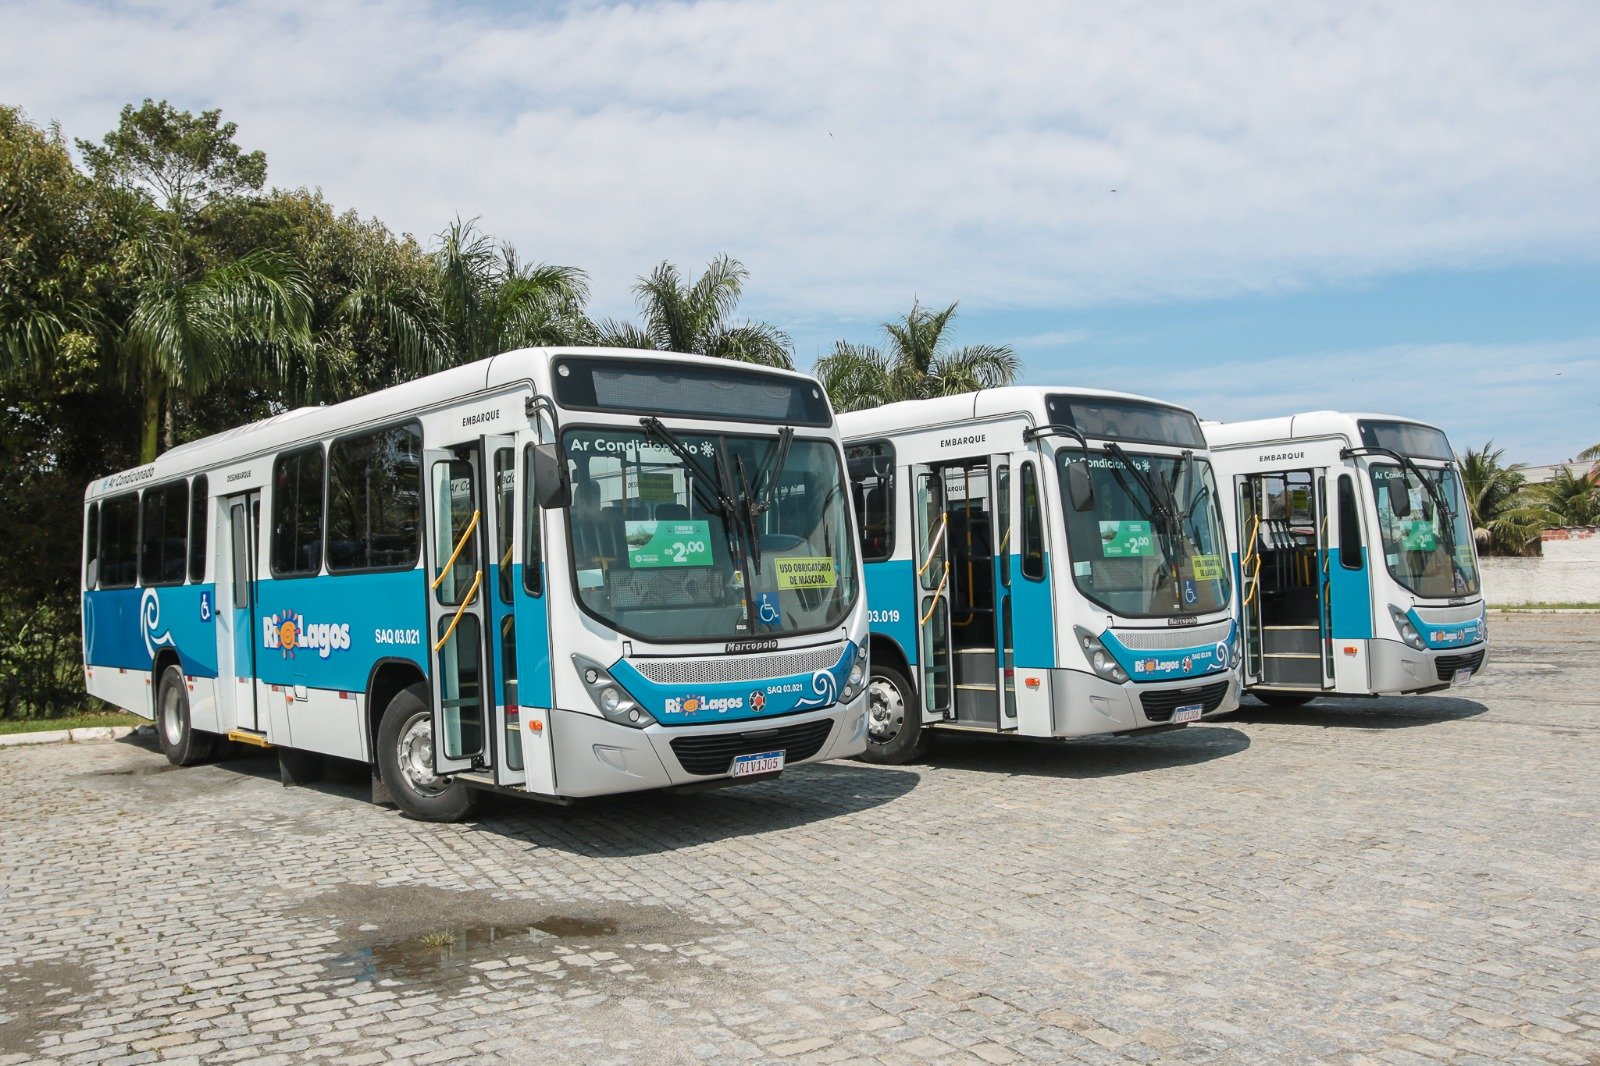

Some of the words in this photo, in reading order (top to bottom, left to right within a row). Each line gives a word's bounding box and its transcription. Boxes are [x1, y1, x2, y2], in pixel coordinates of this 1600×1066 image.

[462, 409, 500, 427] EMBARQUE
[570, 438, 590, 451] Ar
[940, 434, 986, 448] EMBARQUE
[1259, 451, 1305, 462] EMBARQUE
[945, 484, 966, 493] ARQUE
[779, 563, 792, 573] USO
[793, 560, 831, 573] OBRIGATÓRIO
[789, 575, 798, 585] DE
[868, 609, 900, 623] 03.019
[375, 628, 394, 644] SAQ
[395, 628, 420, 645] 03.021
[726, 640, 777, 652] Marcopolo
[766, 685, 782, 695] SAQ
[782, 683, 803, 693] 03.021
